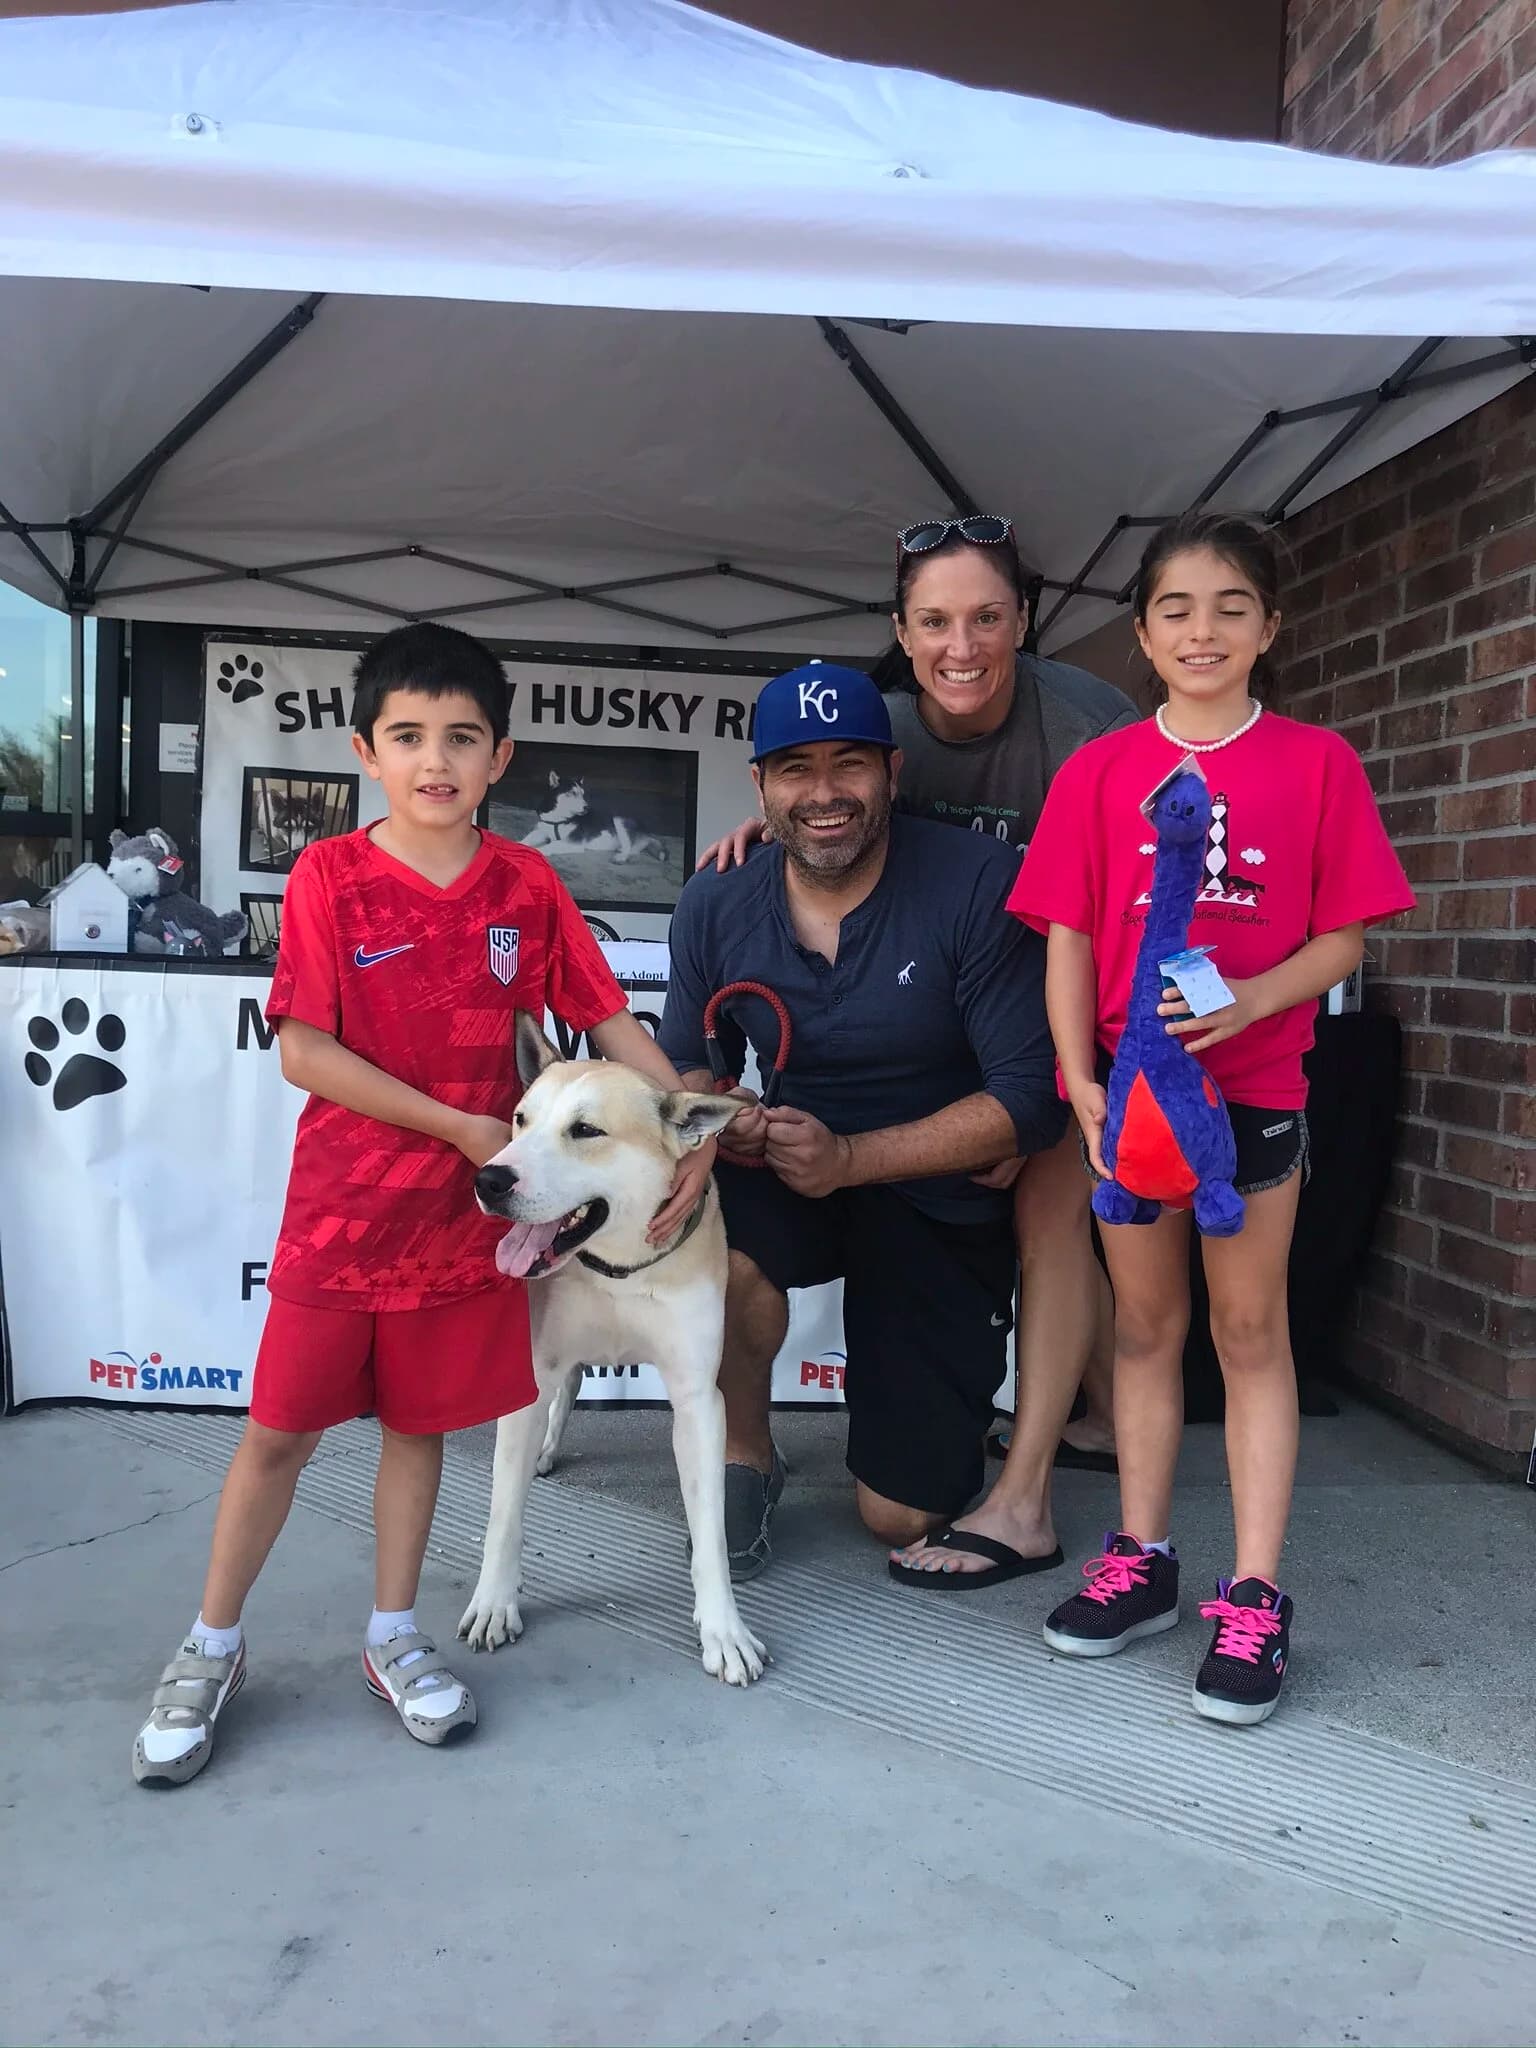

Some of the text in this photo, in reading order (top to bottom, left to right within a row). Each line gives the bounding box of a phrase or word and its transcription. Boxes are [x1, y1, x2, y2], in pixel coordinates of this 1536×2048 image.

[531, 683, 704, 734] HUSKY
[798, 680, 838, 723] KC
[492, 930, 518, 953] USA
[89, 1358, 243, 1393] PETSMART
